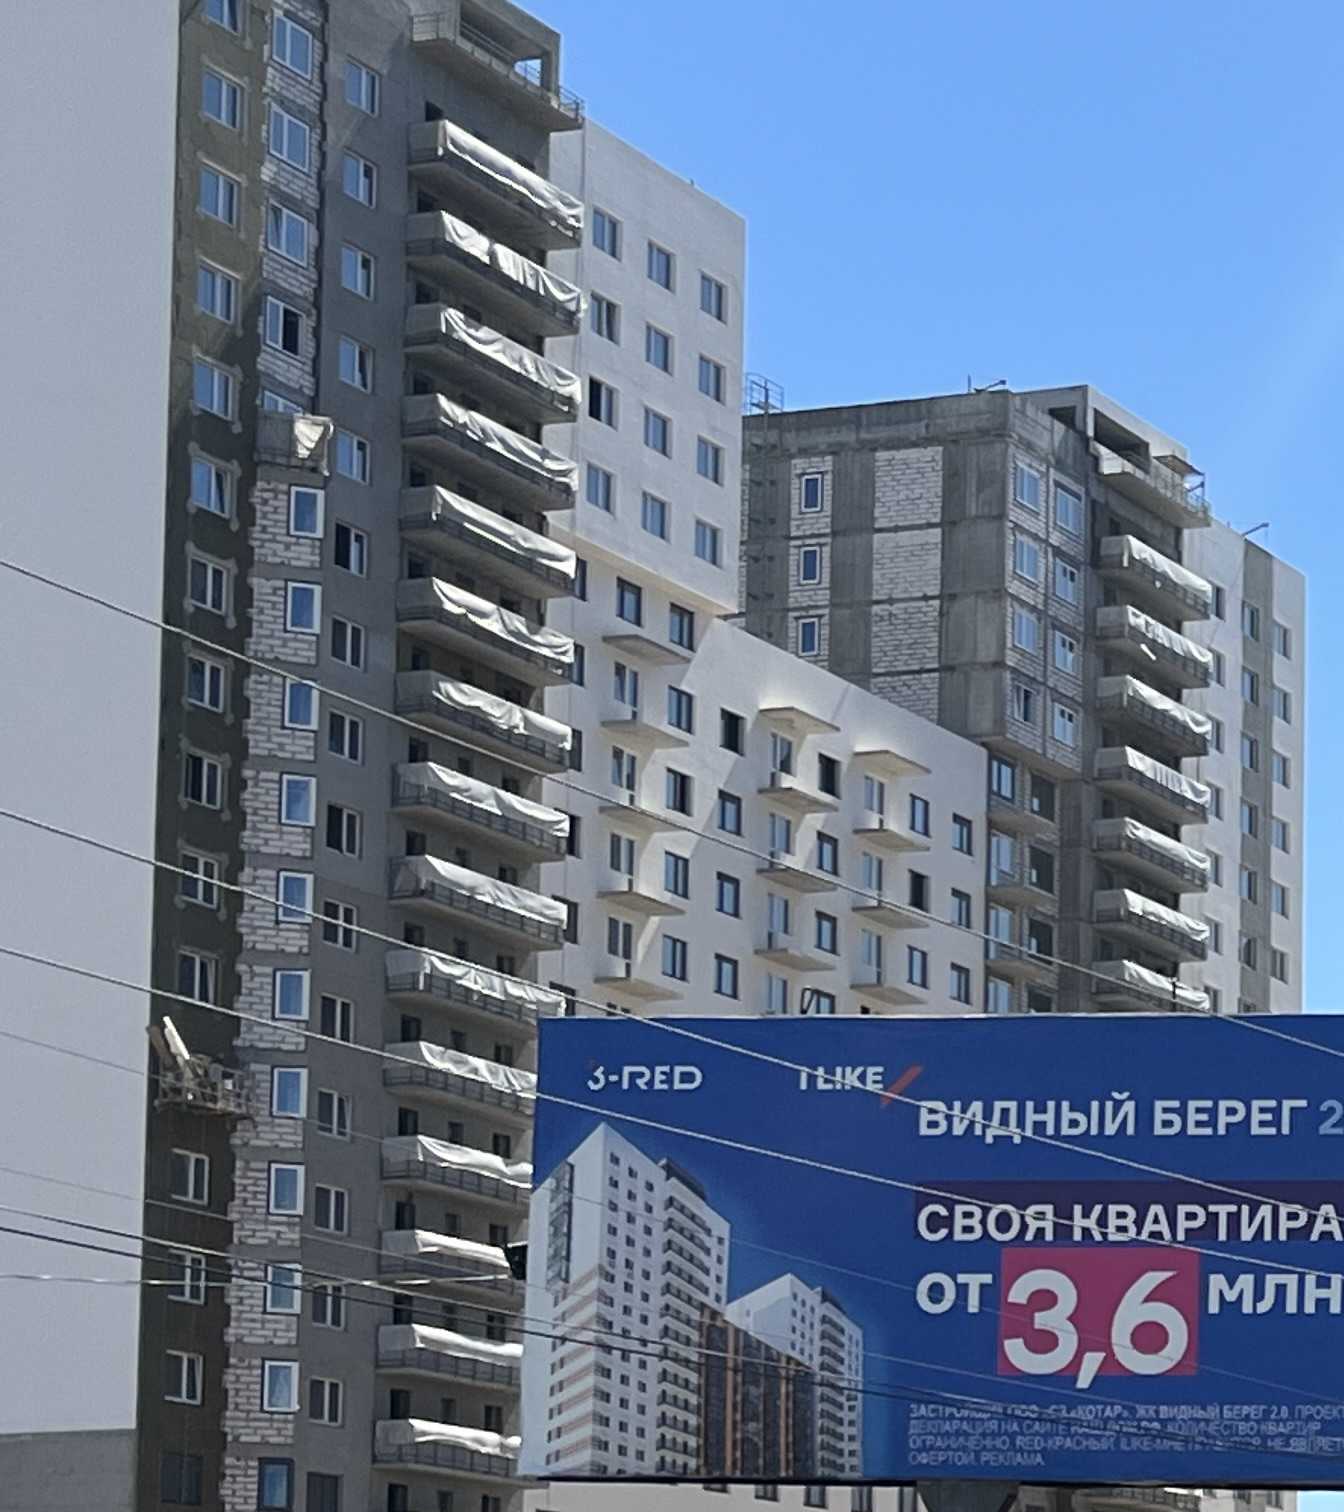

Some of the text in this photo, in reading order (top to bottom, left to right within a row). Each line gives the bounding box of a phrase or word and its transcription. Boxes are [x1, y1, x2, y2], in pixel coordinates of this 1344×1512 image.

[919, 1091, 1136, 1144] ВИДНЫЙ
[1153, 1099, 1308, 1136] БЕРЕГ
[917, 1203, 1344, 1242] СВОЯ КВАРТИРА
[916, 1267, 1344, 1389] ОТ 3,6 МЛН
[1223, 1404, 1268, 1420] БЕРЕГ
